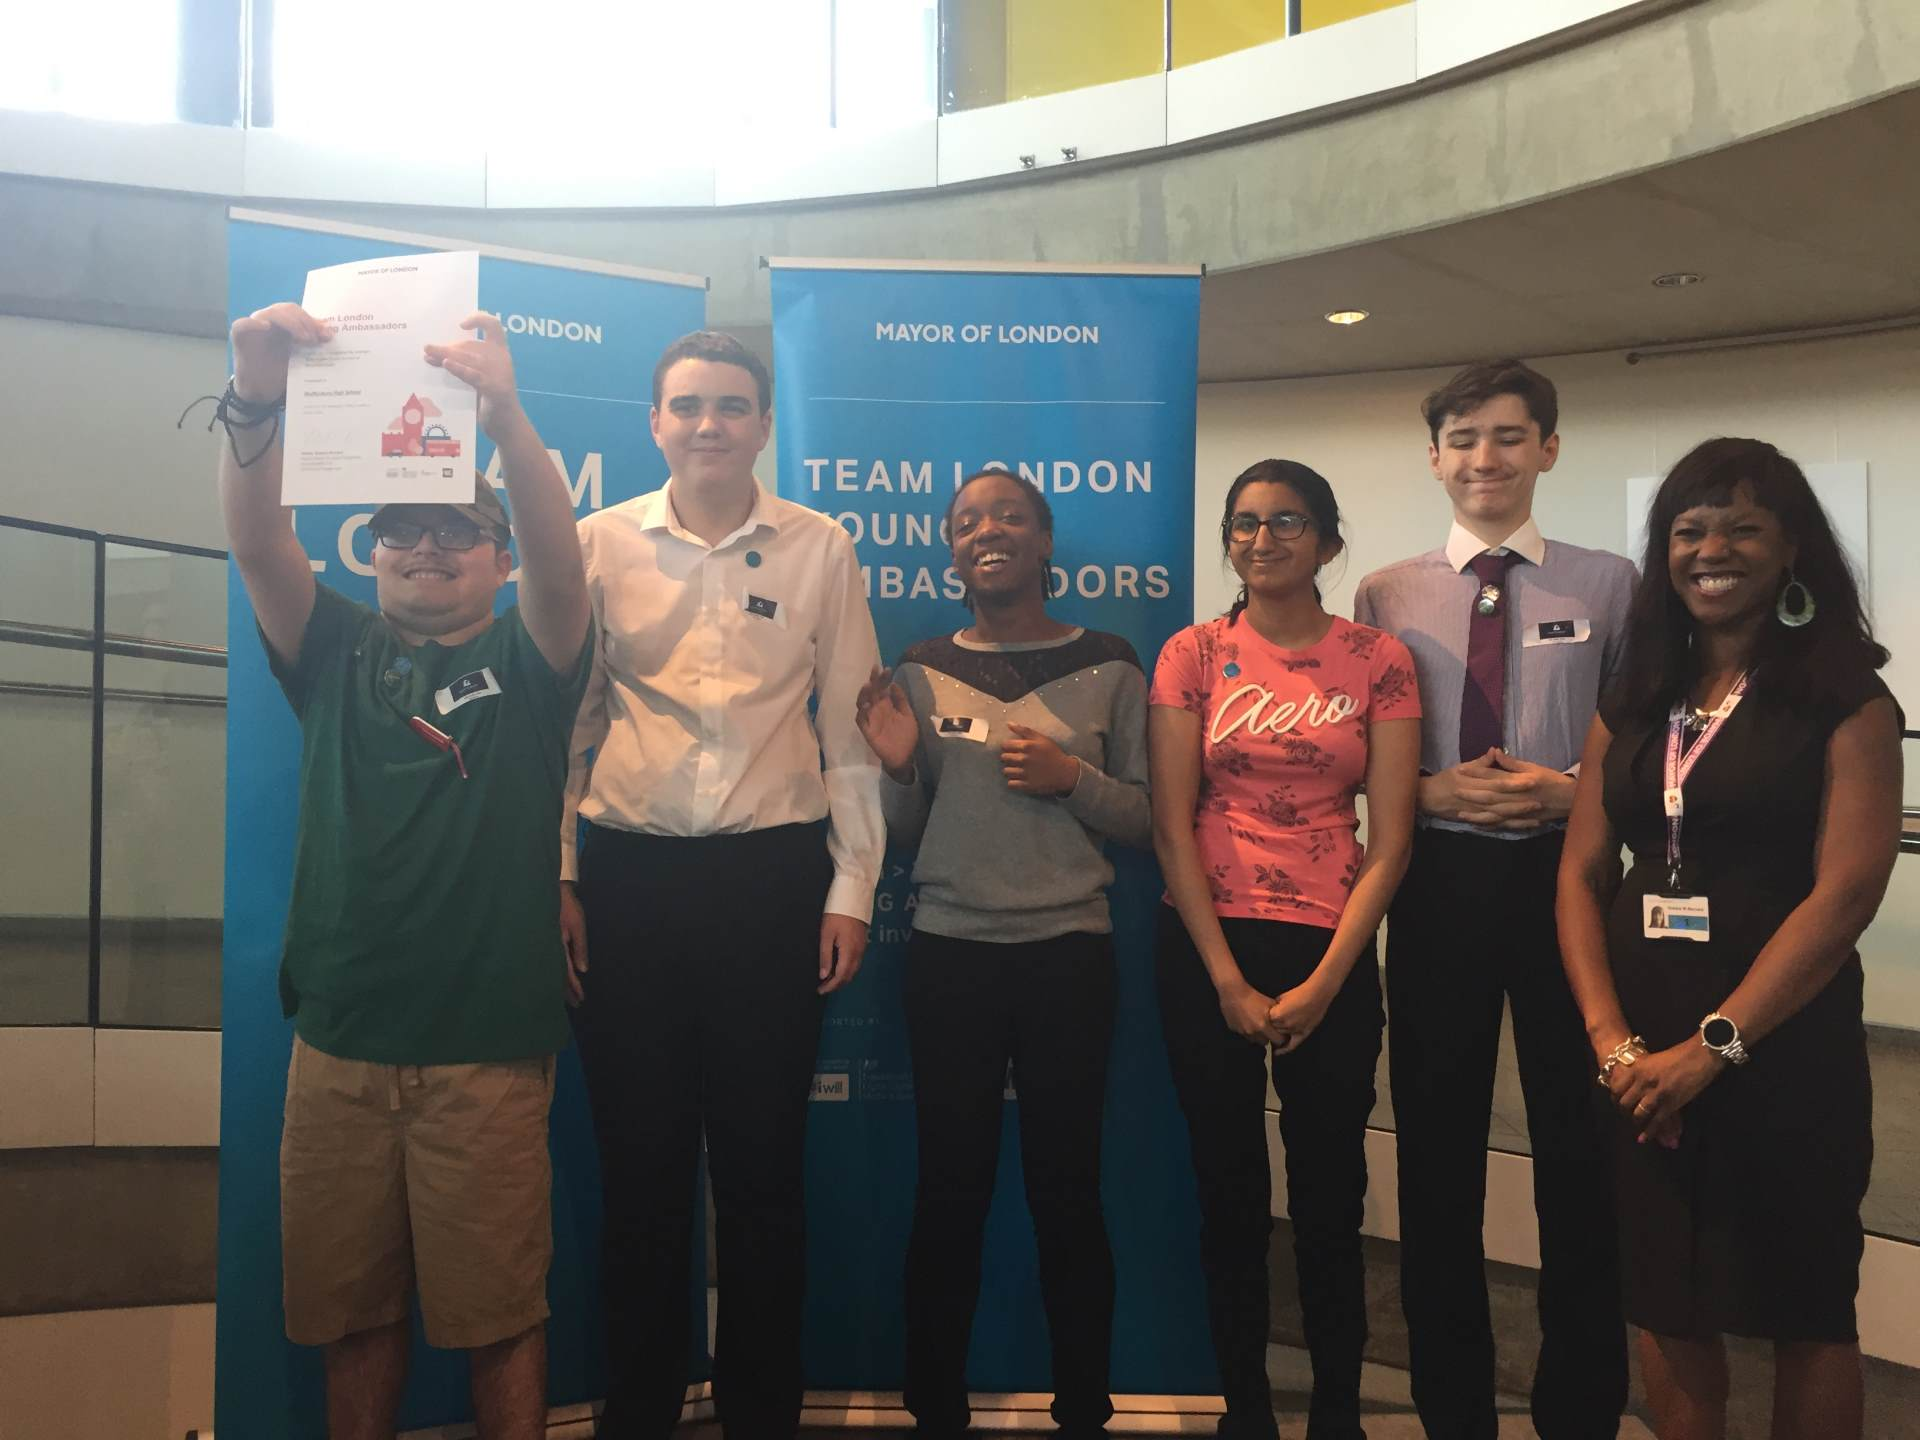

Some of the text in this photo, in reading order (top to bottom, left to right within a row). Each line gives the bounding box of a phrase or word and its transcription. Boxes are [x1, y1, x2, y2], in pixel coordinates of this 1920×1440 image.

[338, 313, 374, 322] London
[342, 322, 407, 332] Ambassadors
[876, 322, 1098, 343] MAYOR OF LONDON
[804, 459, 932, 494] TEAM
[822, 511, 950, 546] OUN
